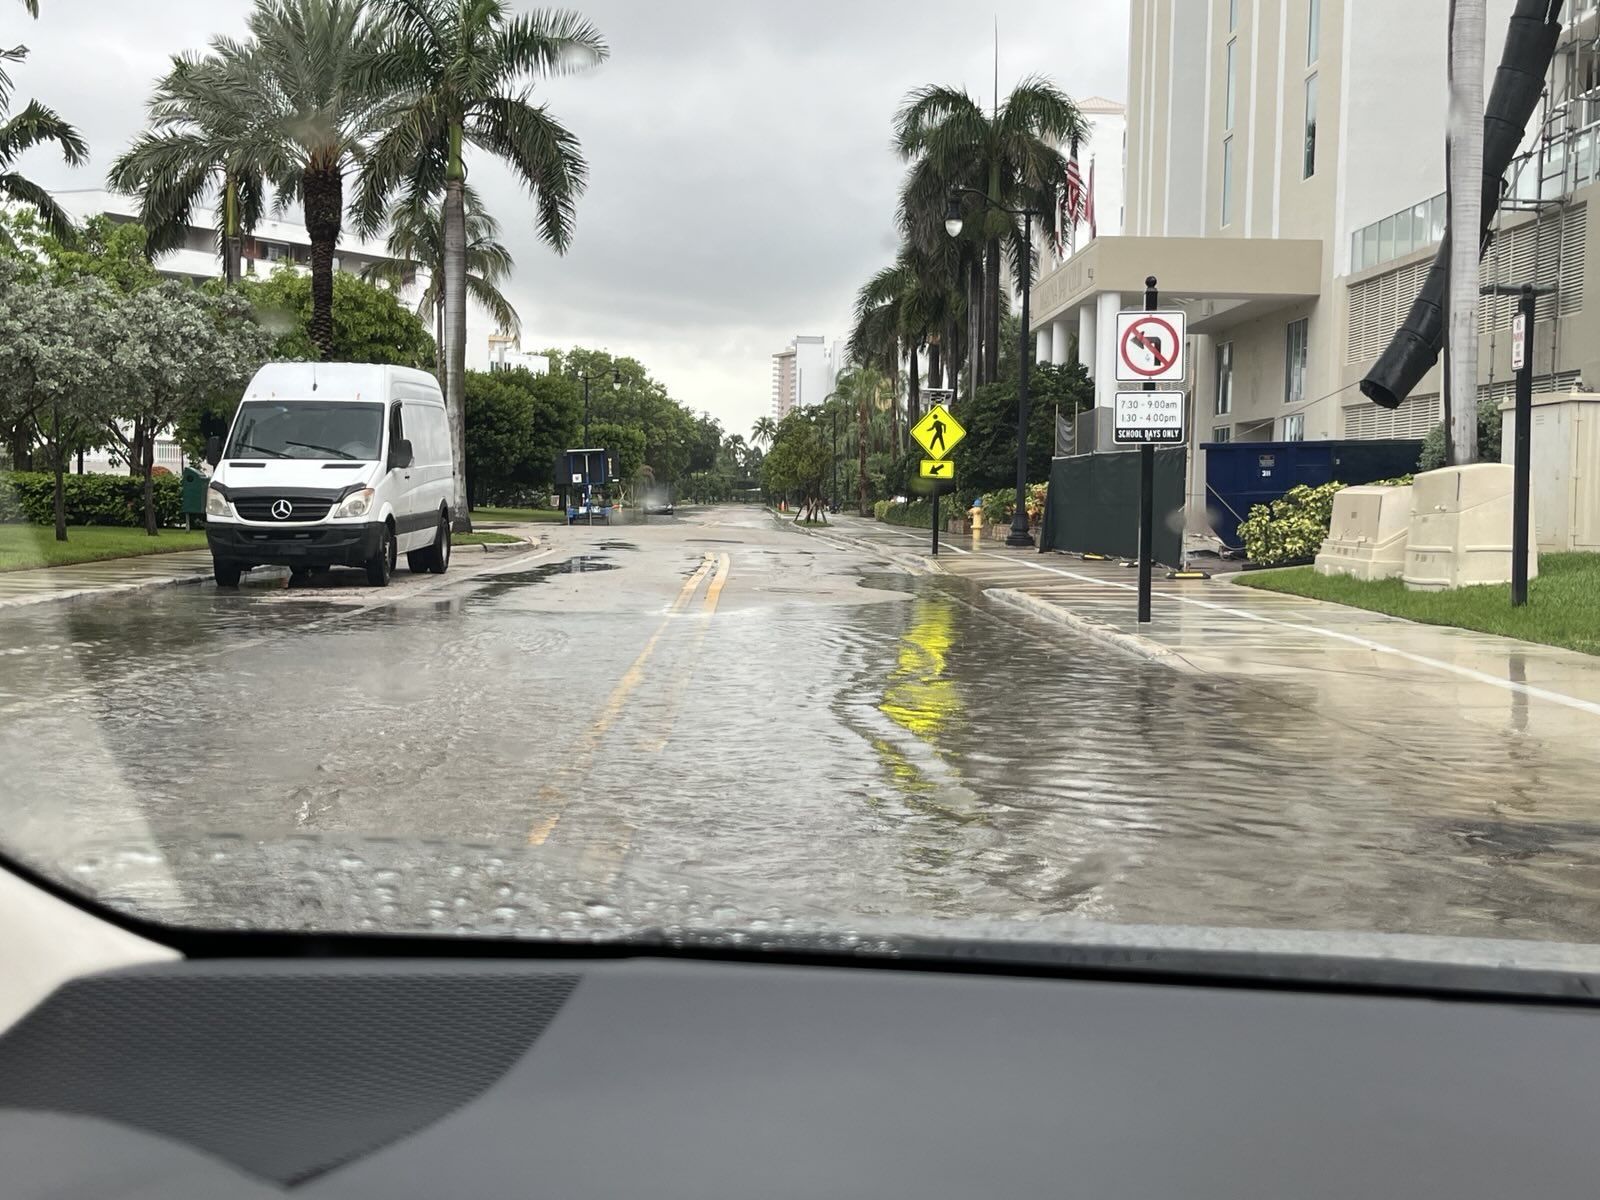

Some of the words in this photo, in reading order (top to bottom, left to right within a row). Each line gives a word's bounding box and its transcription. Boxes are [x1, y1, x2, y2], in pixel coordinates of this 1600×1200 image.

[1118, 430, 1143, 438] SCHOOL
[1144, 430, 1161, 439] DAYS
[1162, 430, 1179, 438] ONLY
